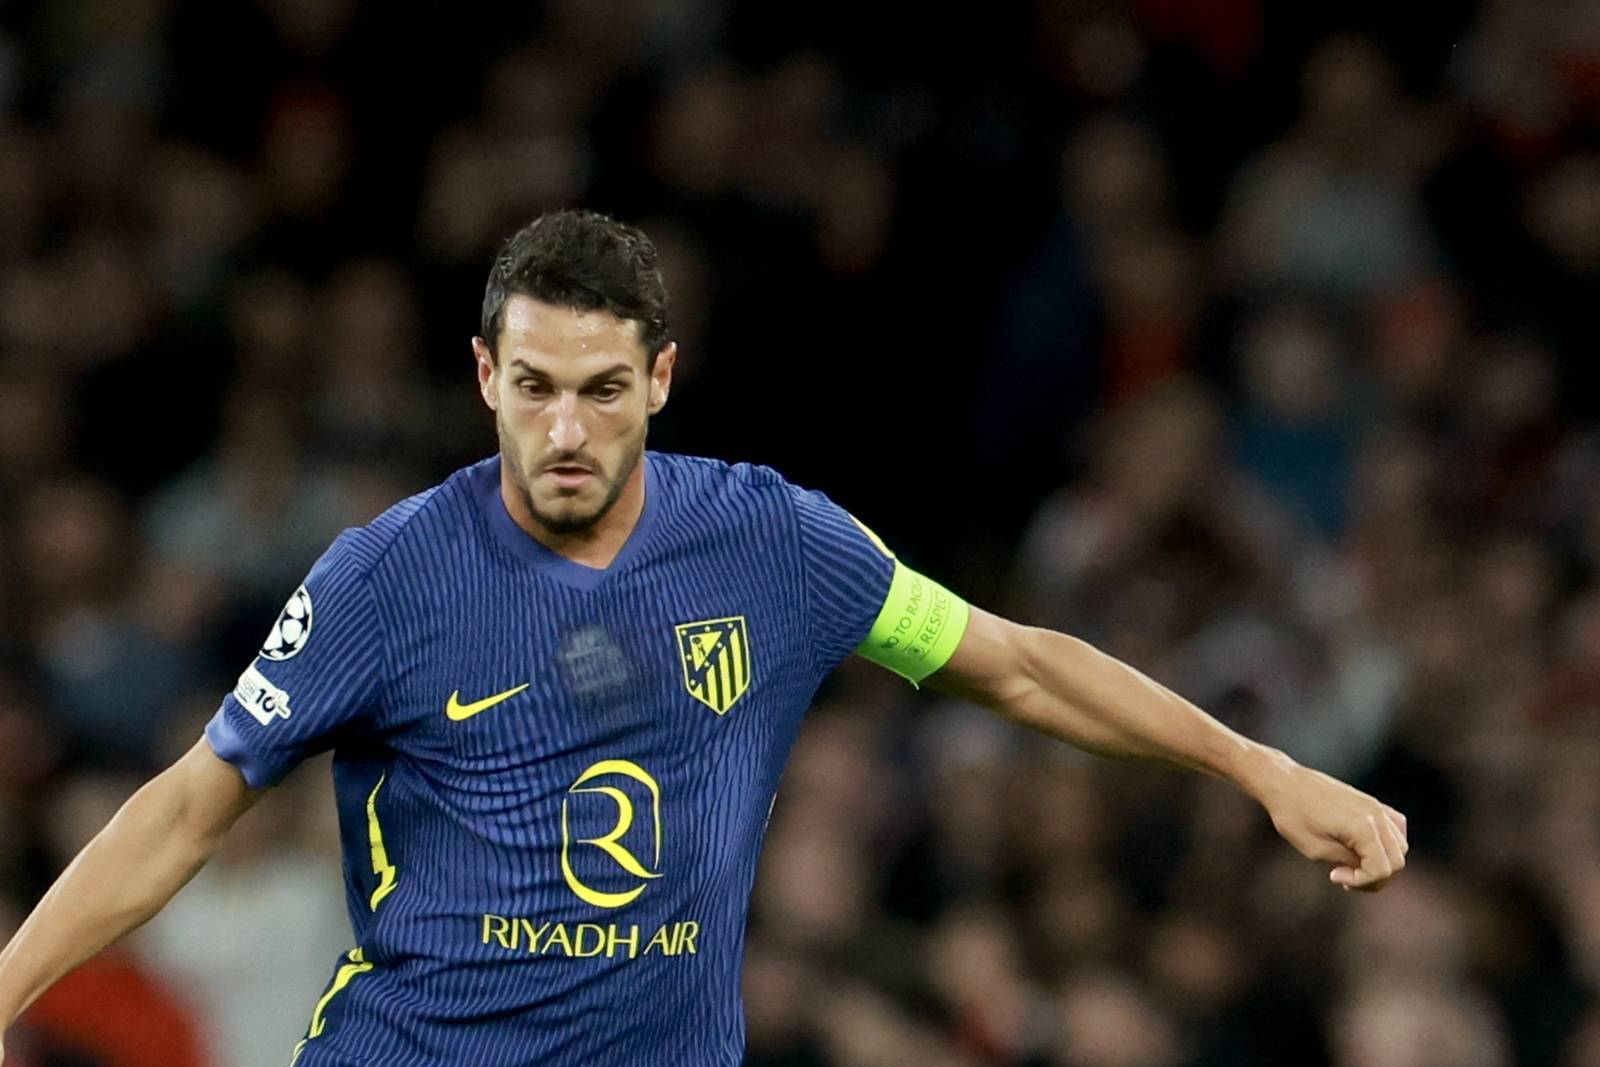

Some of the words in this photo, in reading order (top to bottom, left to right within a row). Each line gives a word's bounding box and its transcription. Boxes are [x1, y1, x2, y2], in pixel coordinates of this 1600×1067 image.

[894, 616, 912, 635] TO
[482, 913, 639, 959] RIYADH
[643, 920, 700, 956] AIR
